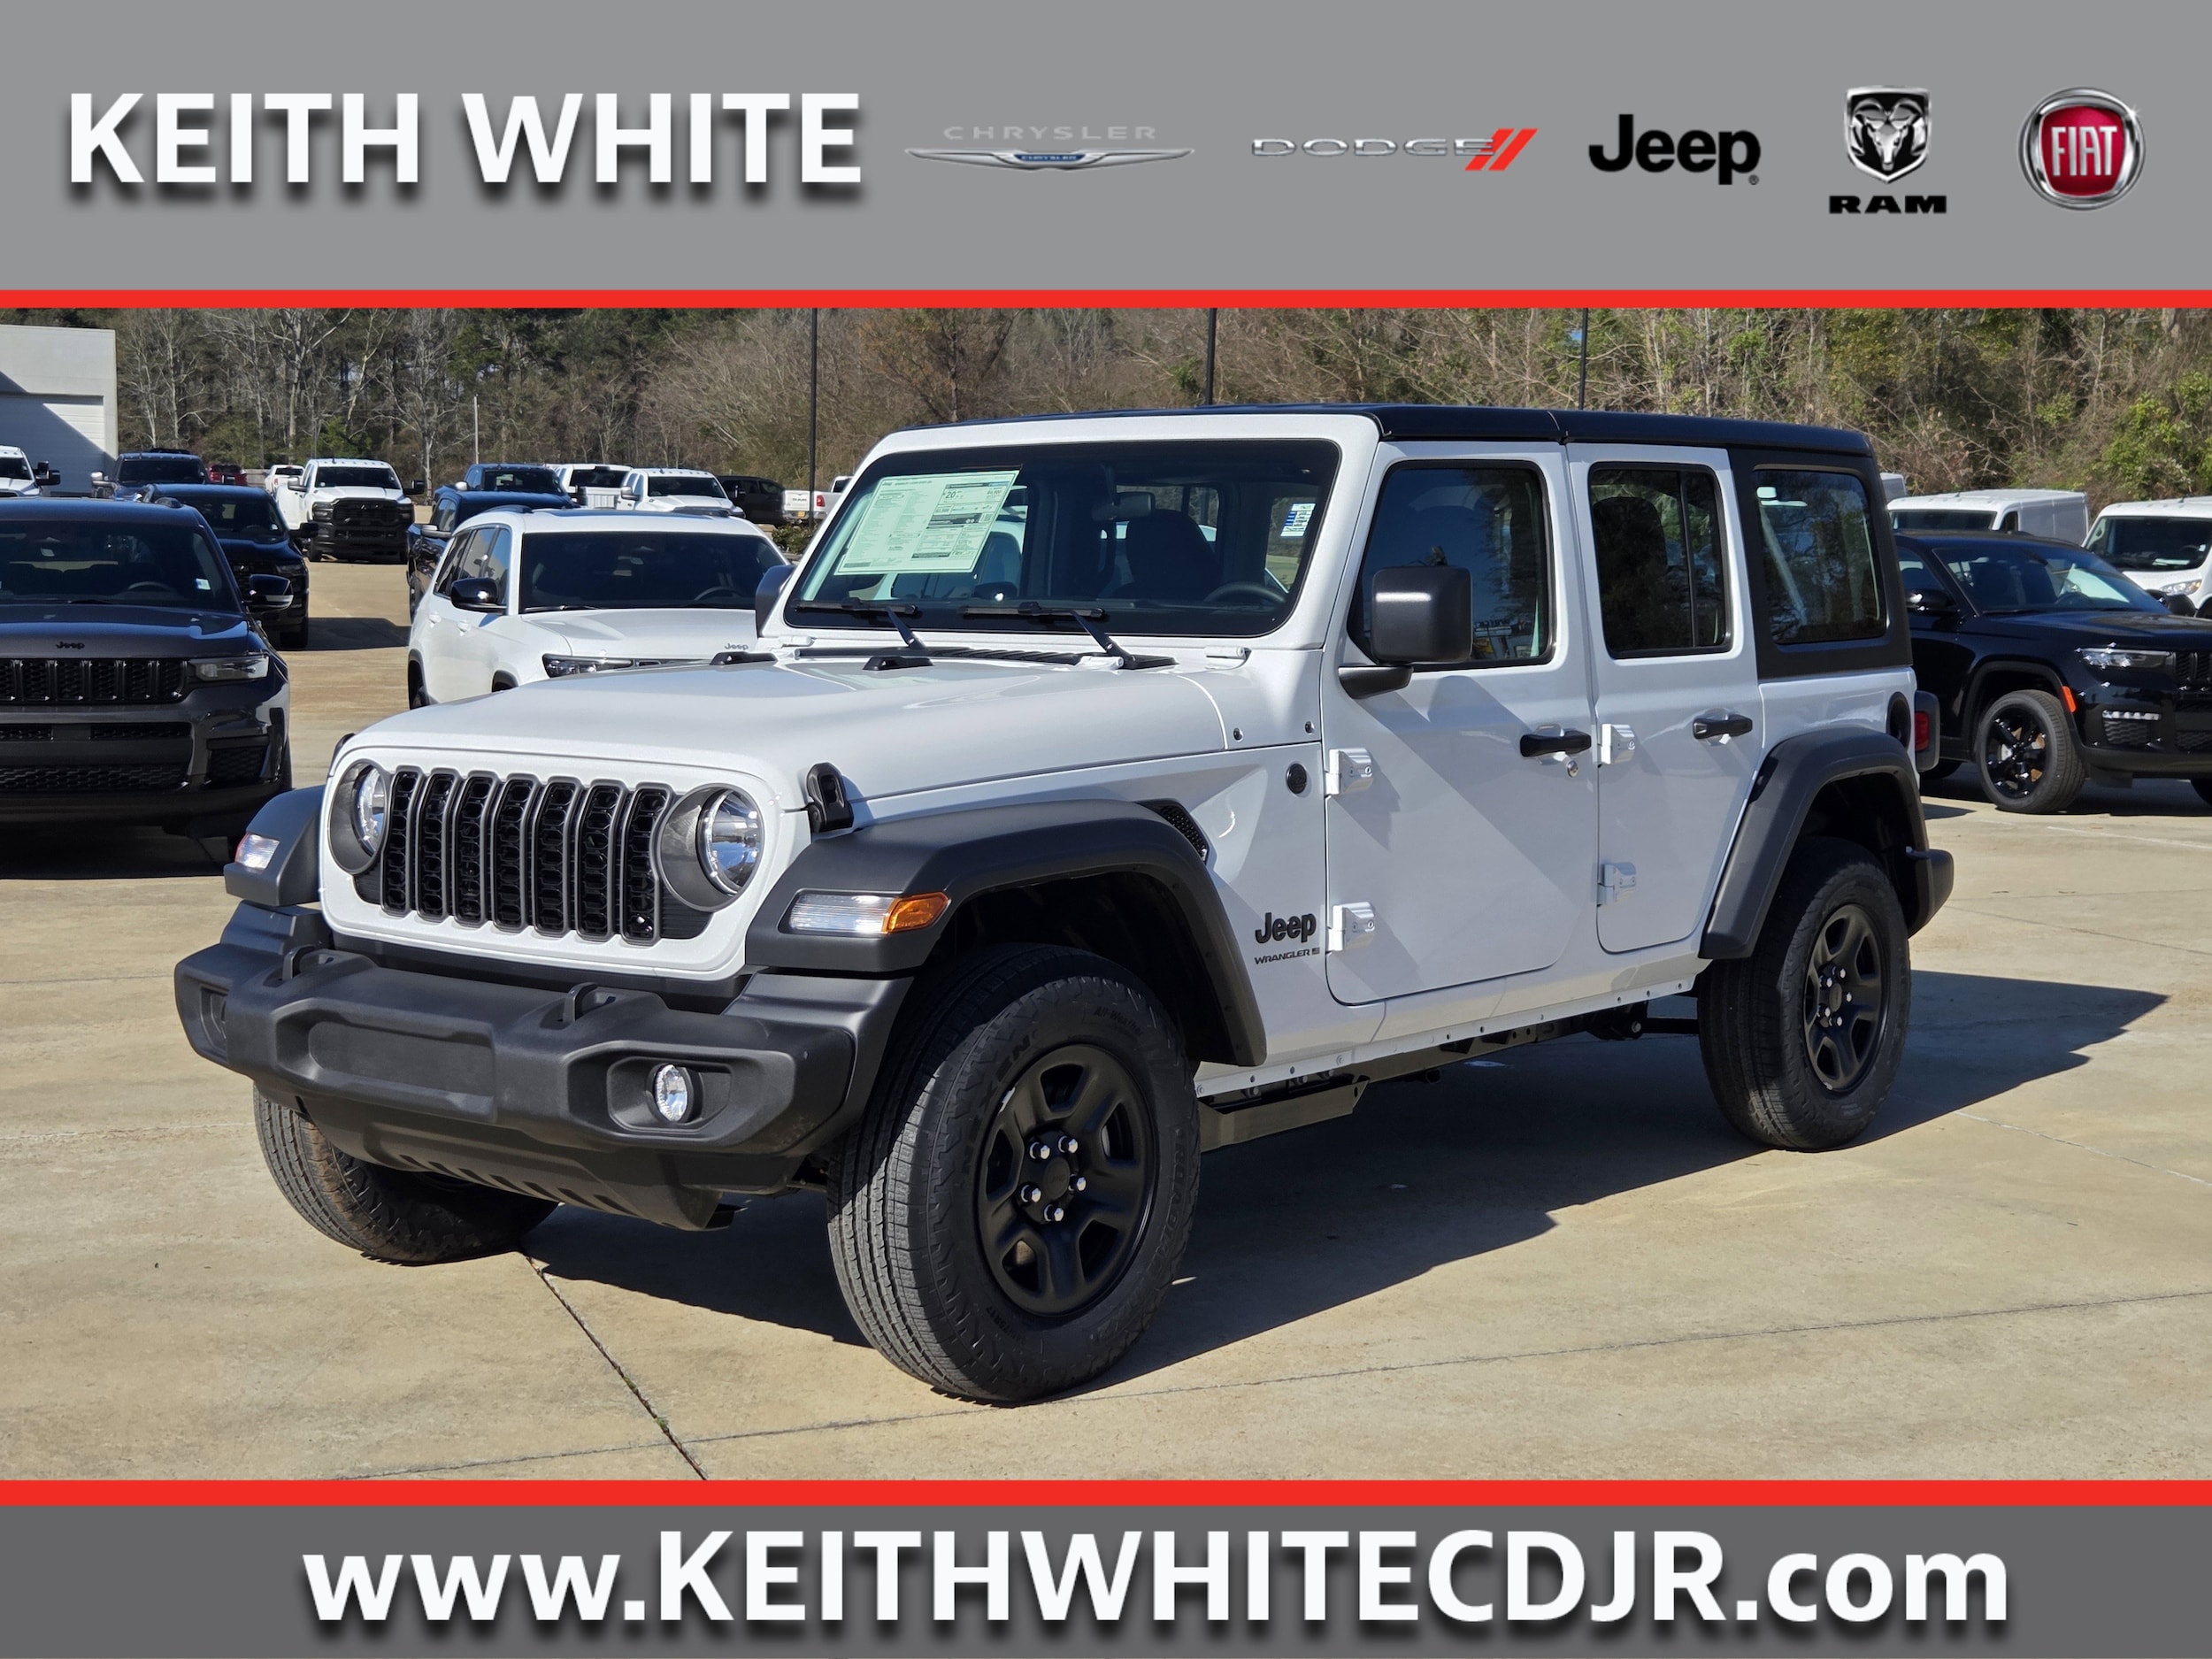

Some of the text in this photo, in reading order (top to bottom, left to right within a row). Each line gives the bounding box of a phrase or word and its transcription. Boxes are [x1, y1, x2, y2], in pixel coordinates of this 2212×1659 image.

[55, 641, 86, 650] Jeep
[1255, 911, 1317, 944] Jeep
[1254, 949, 1310, 965] WRANGLER
